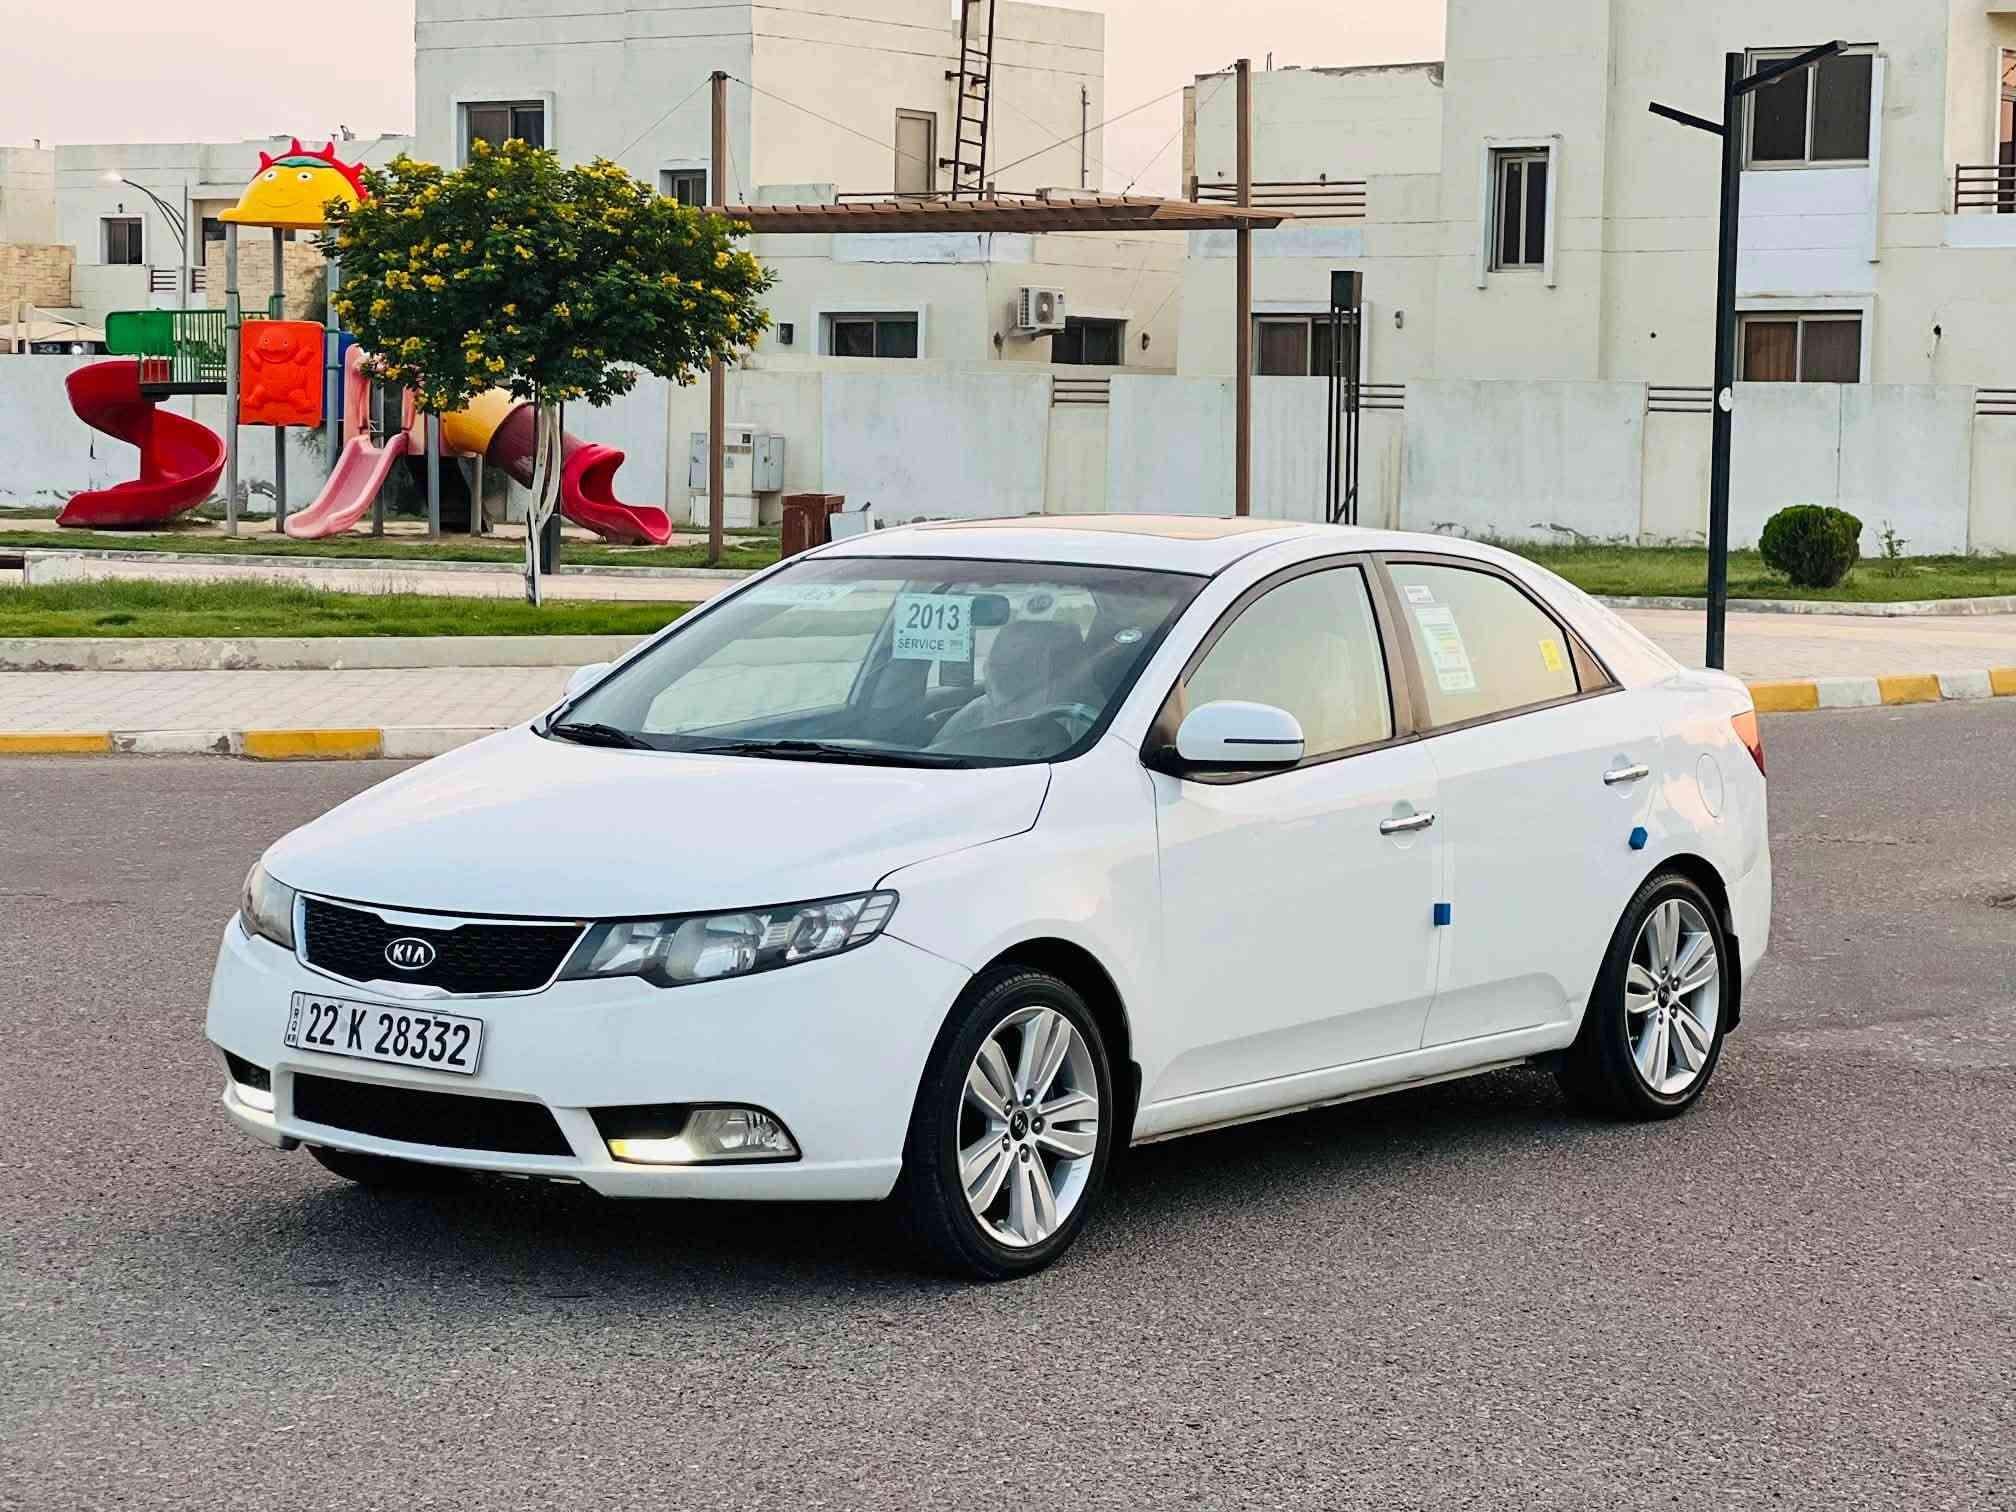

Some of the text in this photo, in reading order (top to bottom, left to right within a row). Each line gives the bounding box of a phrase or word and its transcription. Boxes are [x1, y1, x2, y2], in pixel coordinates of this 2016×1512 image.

[906, 603, 960, 631] 2013
[897, 638, 944, 650] SERVICE
[393, 944, 425, 964] KIA
[305, 1003, 471, 1066] 22 K 28332
